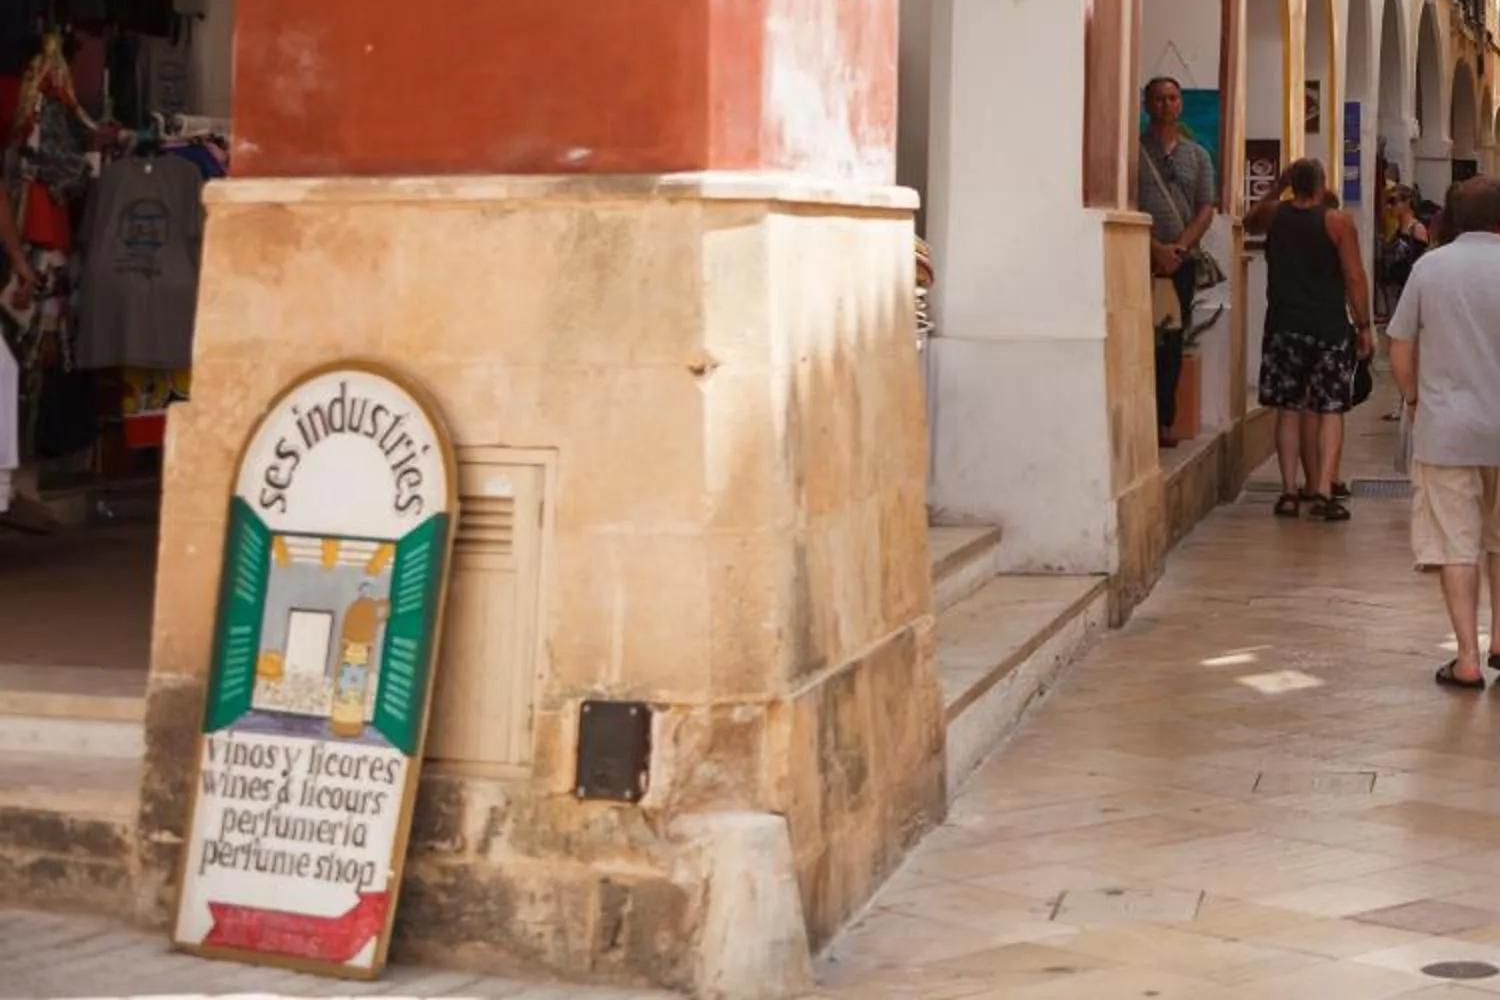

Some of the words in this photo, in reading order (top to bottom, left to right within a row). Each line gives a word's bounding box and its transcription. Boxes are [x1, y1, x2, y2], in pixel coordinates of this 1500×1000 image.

[281, 747, 301, 776] y
[307, 742, 400, 785] licores
[313, 851, 376, 894] shop
